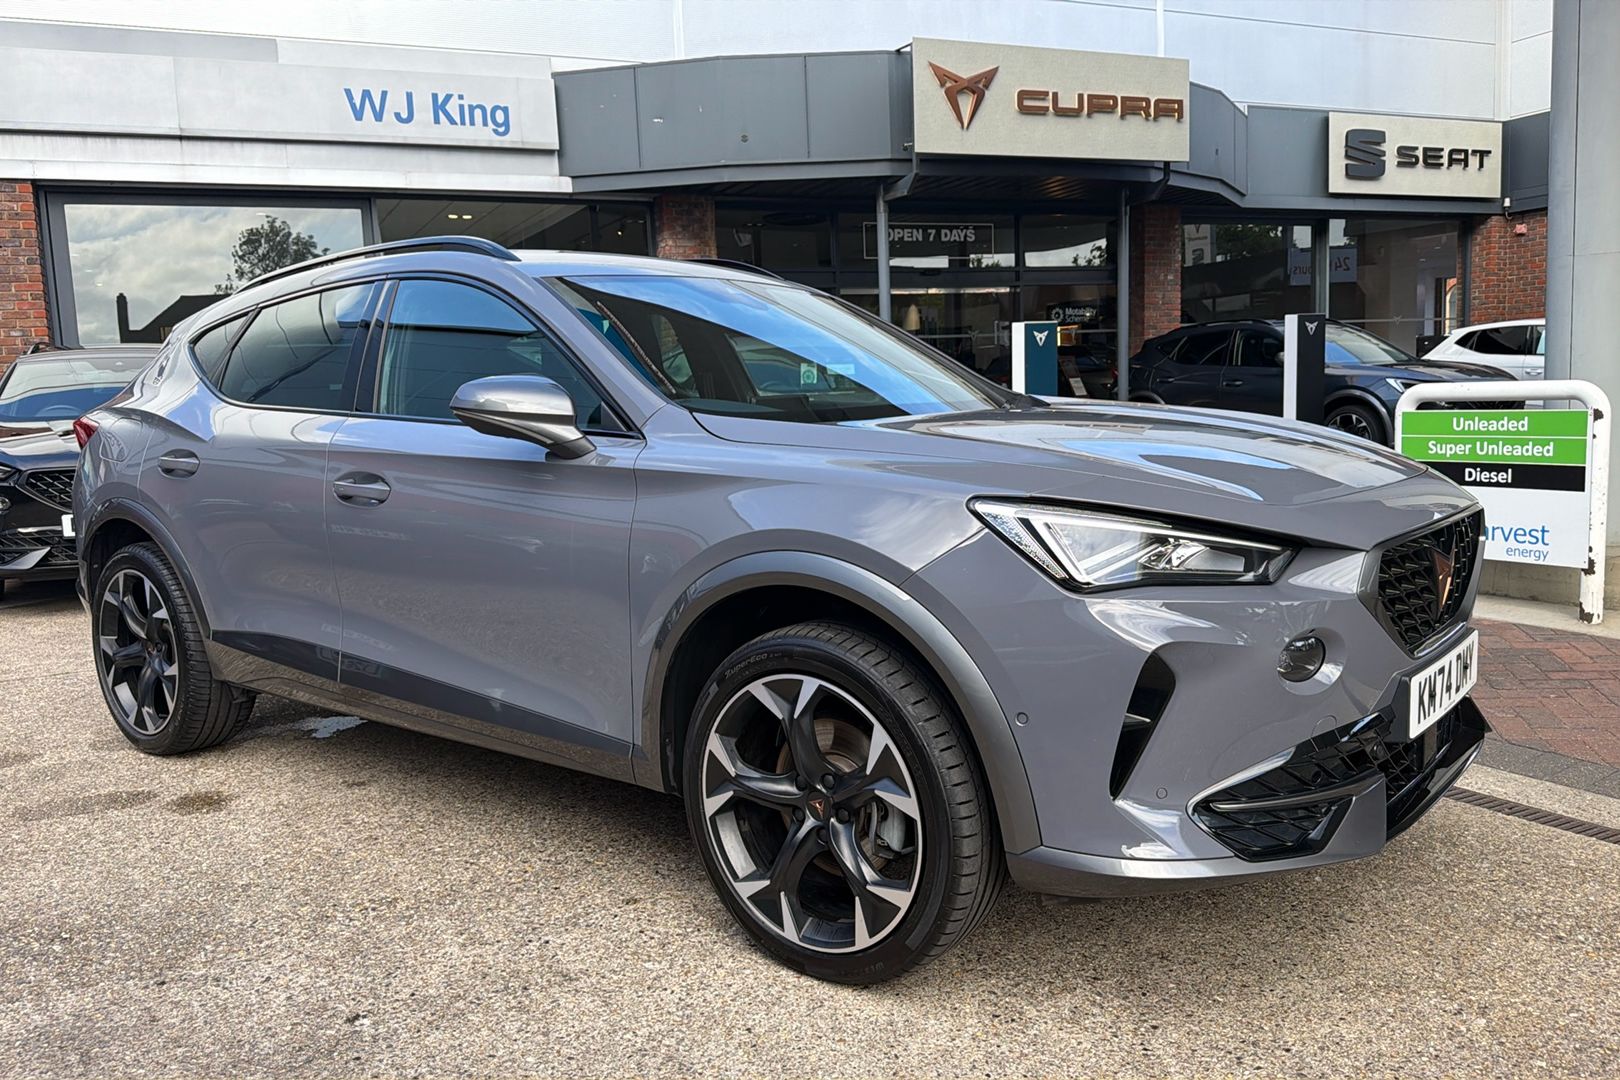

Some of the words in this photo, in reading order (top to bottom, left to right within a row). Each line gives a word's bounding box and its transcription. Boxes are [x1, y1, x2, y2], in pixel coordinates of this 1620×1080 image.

[1016, 89, 1184, 122] CUPRA
[431, 92, 511, 137] King
[1396, 145, 1492, 170] SEAT
[927, 229, 936, 241] 7
[941, 228, 975, 241] DAYS
[1452, 417, 1528, 431] Unleaded
[1428, 440, 1472, 457] Super
[1476, 441, 1554, 457] Unleaded
[1464, 468, 1512, 483] Diesel
[1484, 525, 1549, 546] rvest
[1506, 547, 1549, 562] energy
